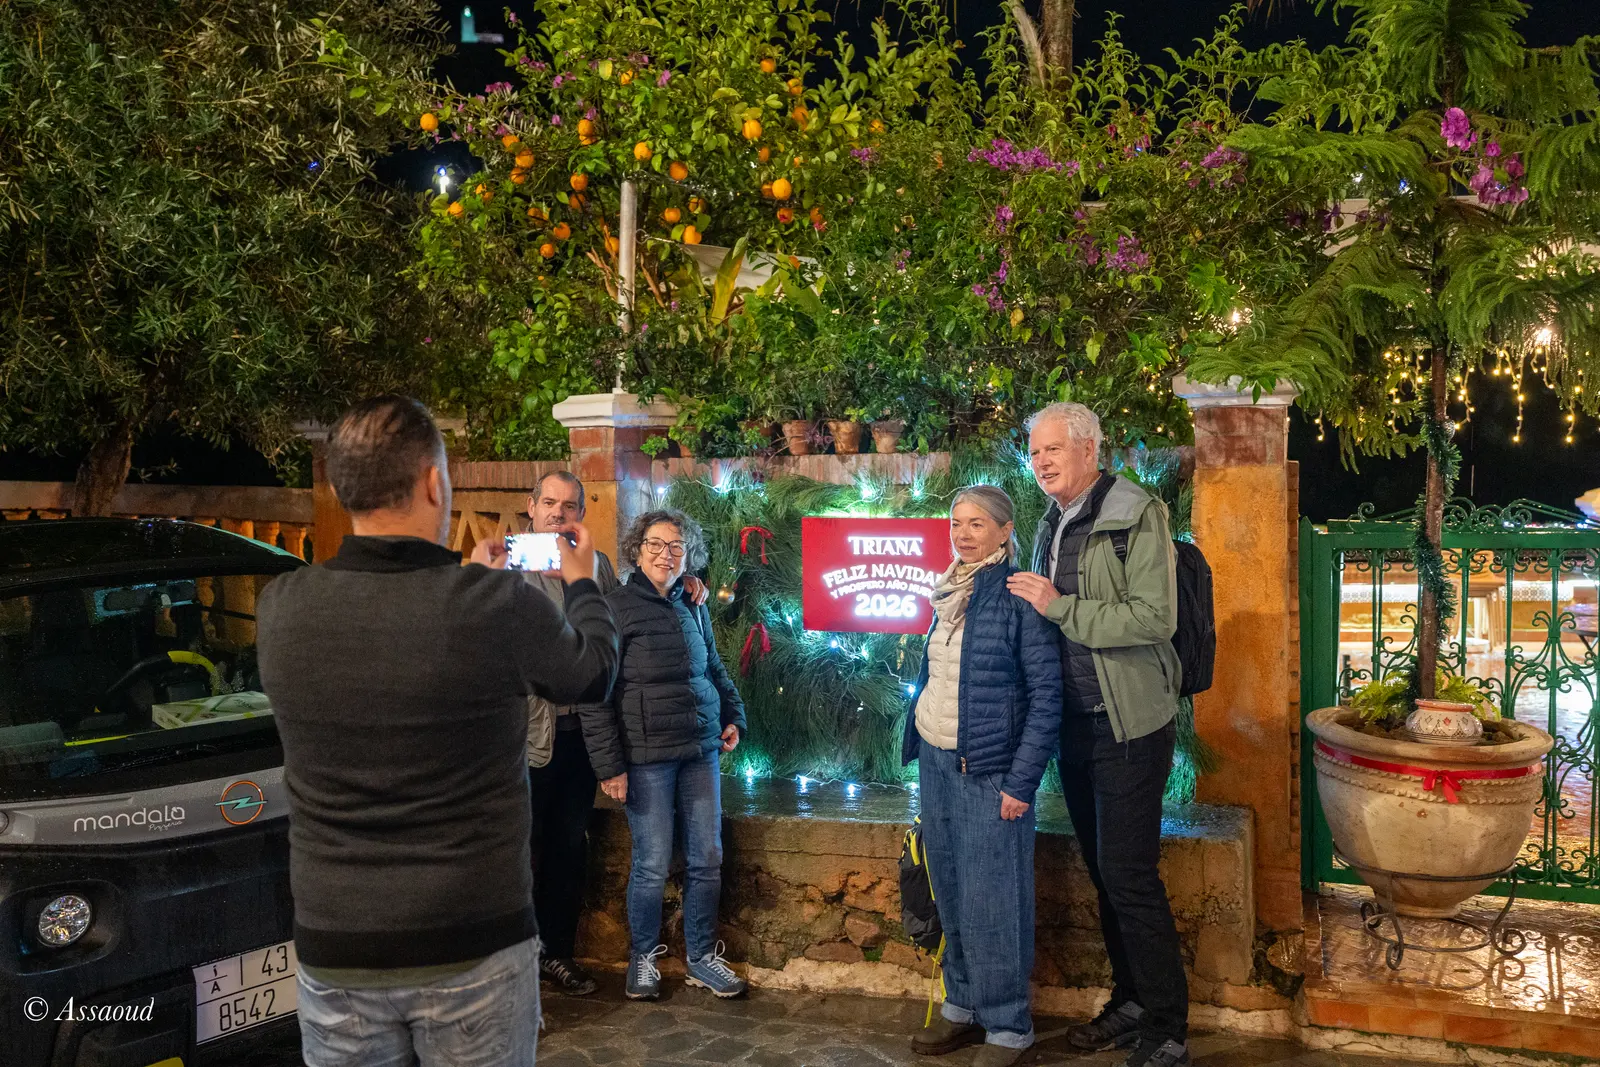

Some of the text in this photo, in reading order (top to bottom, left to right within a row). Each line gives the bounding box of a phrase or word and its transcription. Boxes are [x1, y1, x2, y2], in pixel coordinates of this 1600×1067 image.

[848, 536, 923, 556] TRIANA
[822, 564, 869, 588] FELIZ
[830, 589, 839, 599] Y
[837, 580, 886, 596] PROSPERO
[886, 579, 908, 591] AÑO
[854, 593, 917, 618] 2026
[74, 805, 185, 832] mandala
[261, 945, 288, 977] 43
[210, 980, 221, 995] A
[219, 988, 276, 1032] 8542
